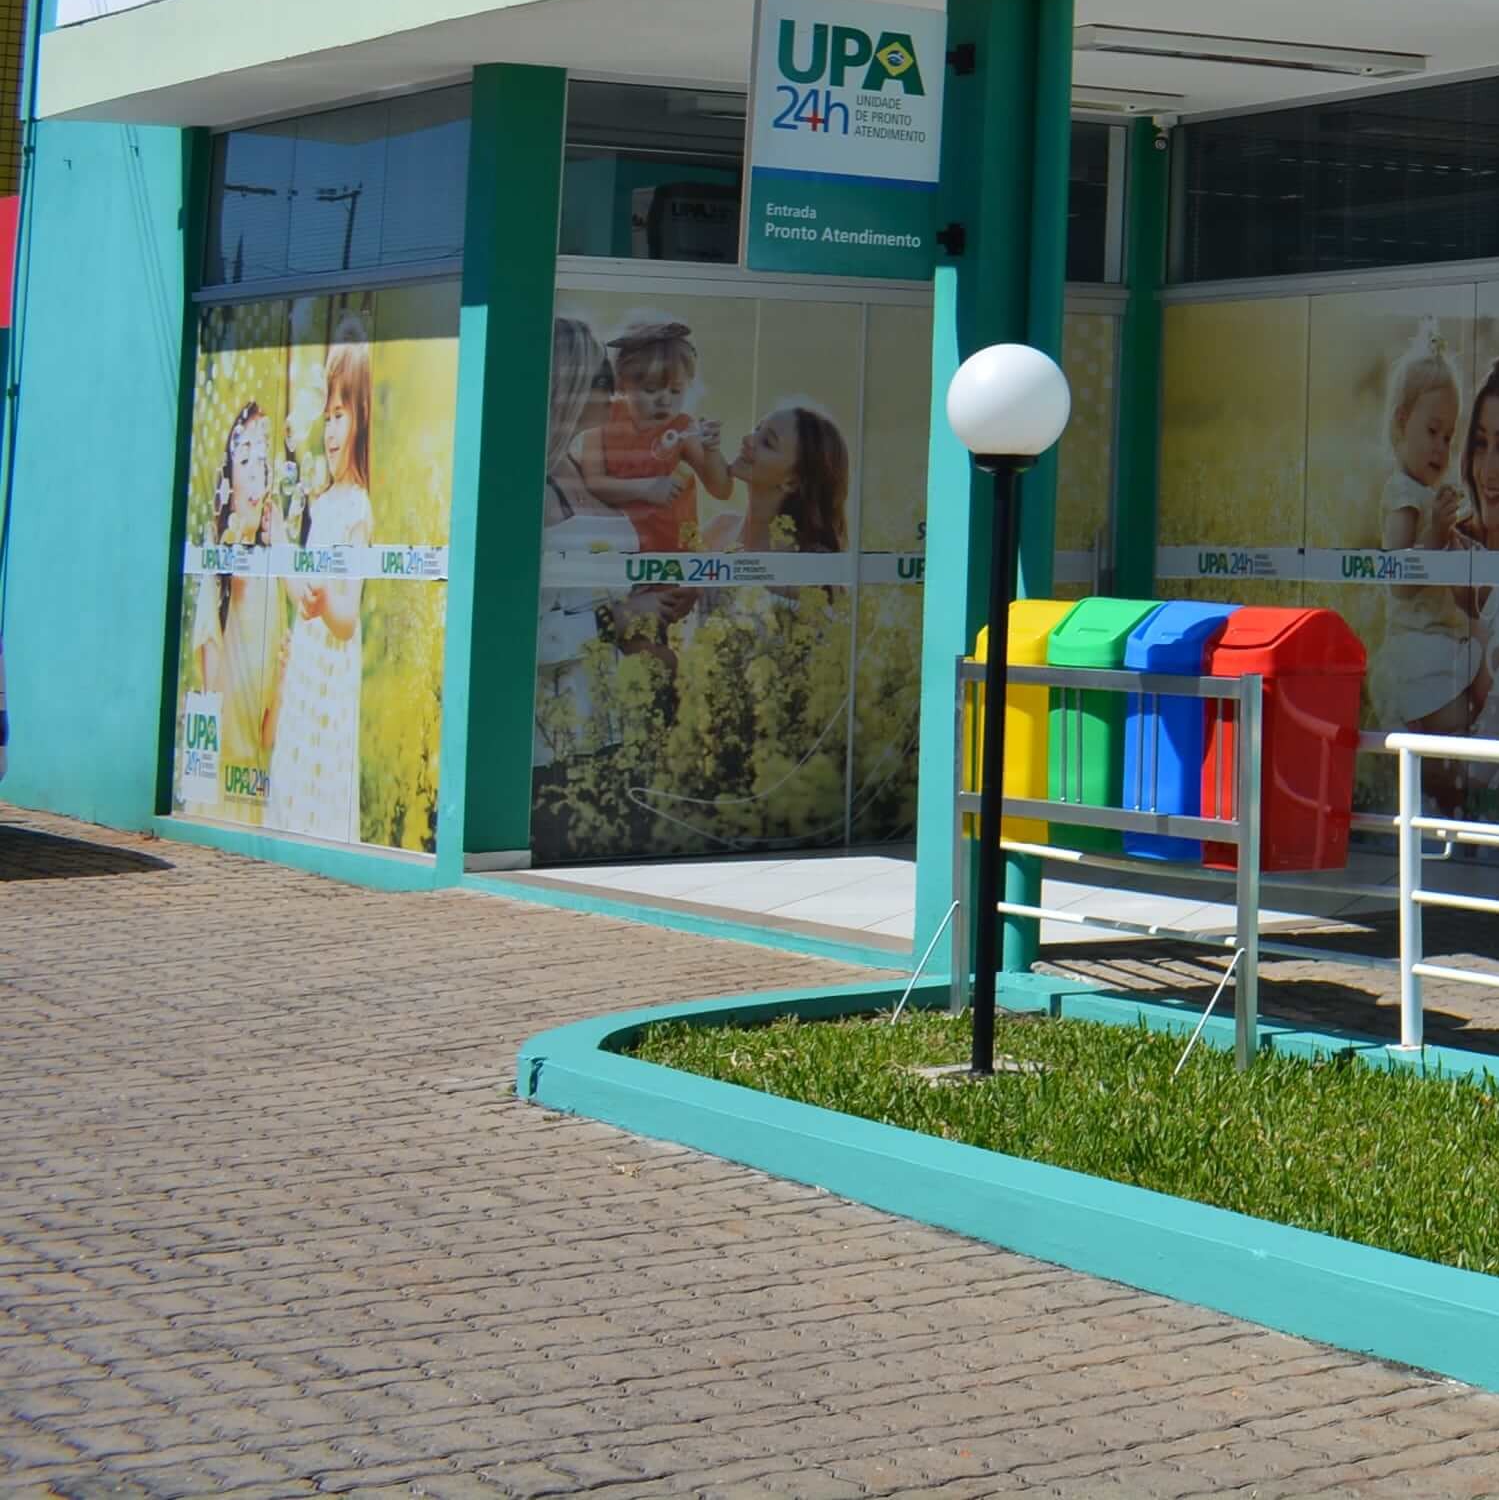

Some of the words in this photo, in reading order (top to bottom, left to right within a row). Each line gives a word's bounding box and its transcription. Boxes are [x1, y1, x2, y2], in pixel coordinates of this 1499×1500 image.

[777, 18, 926, 97] UPA
[772, 84, 850, 136] 24h
[855, 95, 902, 111] UNIDADE
[855, 110, 869, 123] DE
[870, 111, 913, 127] PRONTO
[854, 124, 927, 144] ATENDIMENTO
[765, 202, 818, 221] Entrada
[764, 222, 818, 242] Pronto
[821, 226, 922, 249] Atendimento
[625, 558, 685, 582] UPA
[688, 558, 731, 582] 24h
[1198, 552, 1229, 574] UPA
[1342, 555, 1375, 578] UPA
[186, 712, 218, 751] UPA
[224, 765, 250, 794] UPA
